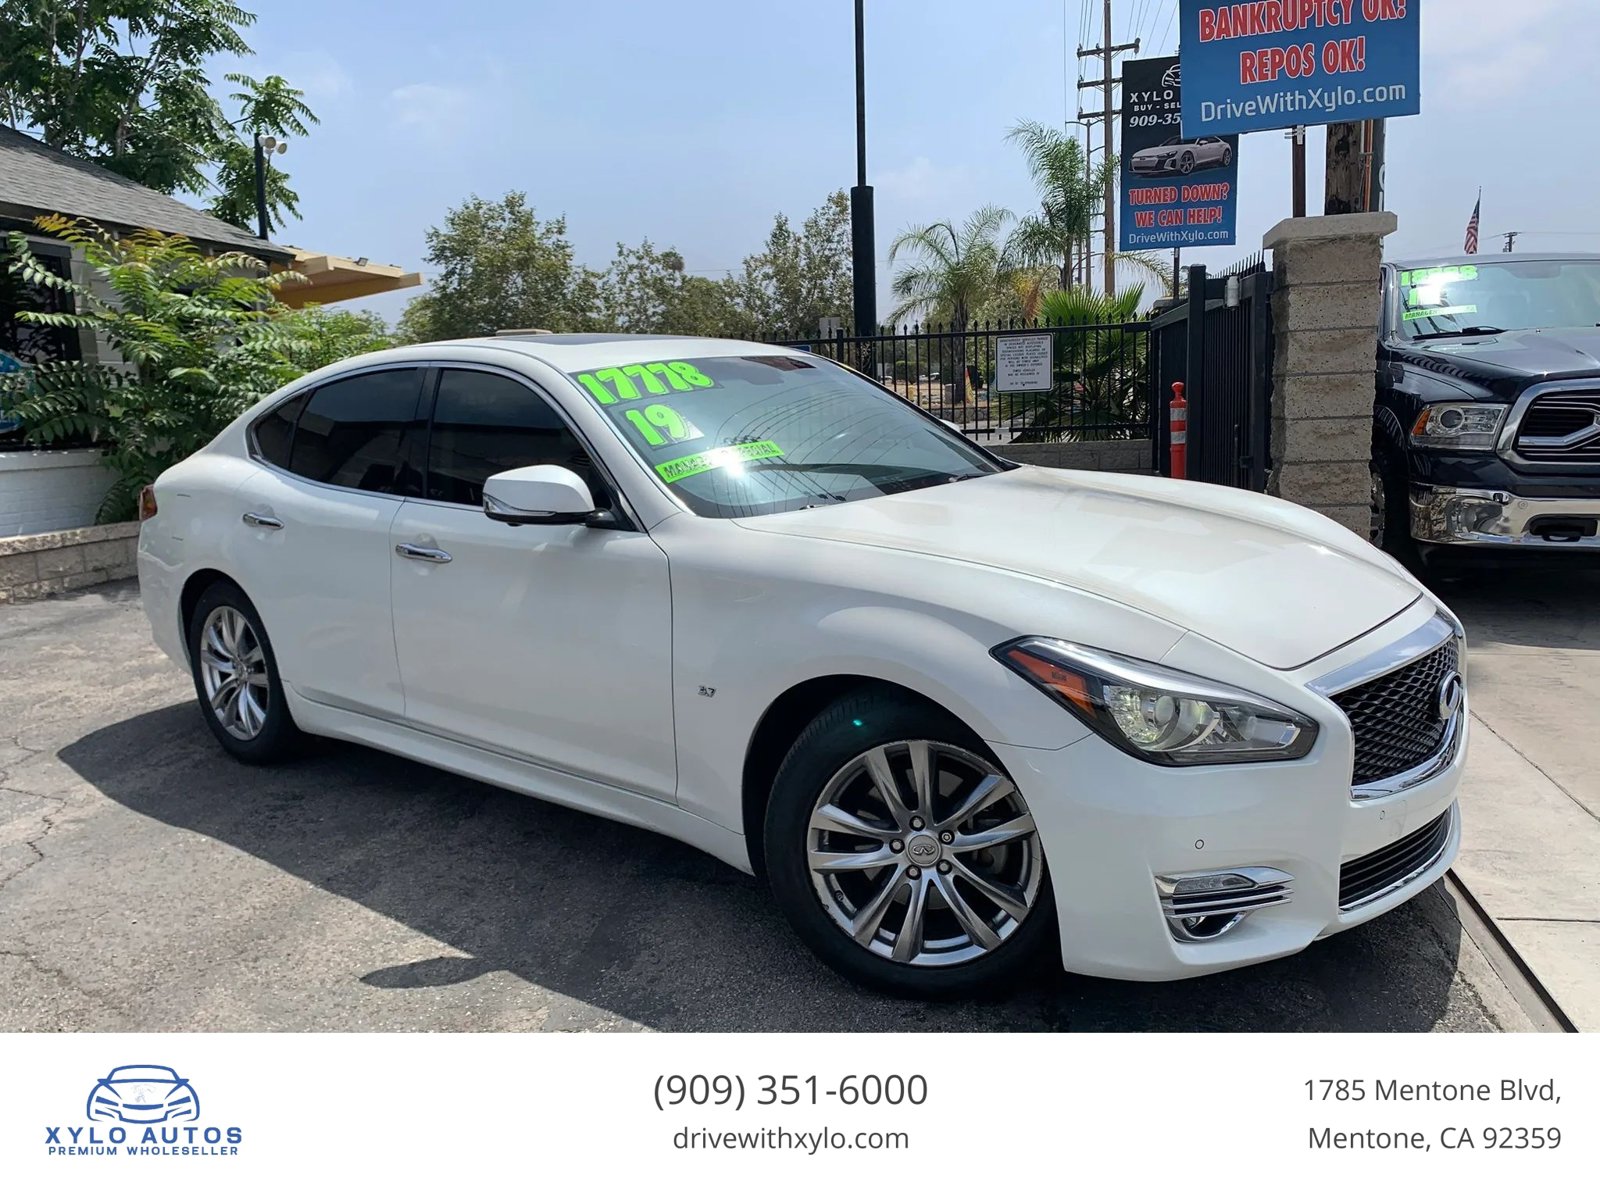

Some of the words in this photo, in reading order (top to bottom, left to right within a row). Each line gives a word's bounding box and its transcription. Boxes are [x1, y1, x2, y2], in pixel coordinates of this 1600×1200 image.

[1199, 0, 1353, 42] BANKRUPTCY
[1362, 0, 1406, 22] OK!
[1240, 43, 1315, 84] REPOS
[1322, 36, 1365, 74] OK!
[1129, 90, 1173, 103] XYLO
[1133, 104, 1153, 112] BUY
[1201, 84, 1406, 122] DriveWithXylo.com
[1129, 186, 1178, 206] TURNED
[1181, 182, 1230, 203] DOWN?
[1135, 211, 1154, 228] WE
[1158, 209, 1183, 226] CAN
[1187, 206, 1222, 225] HELP!
[1129, 230, 1229, 244] DriveWithXylo.com
[578, 361, 715, 405] 17778
[626, 404, 690, 446] 19
